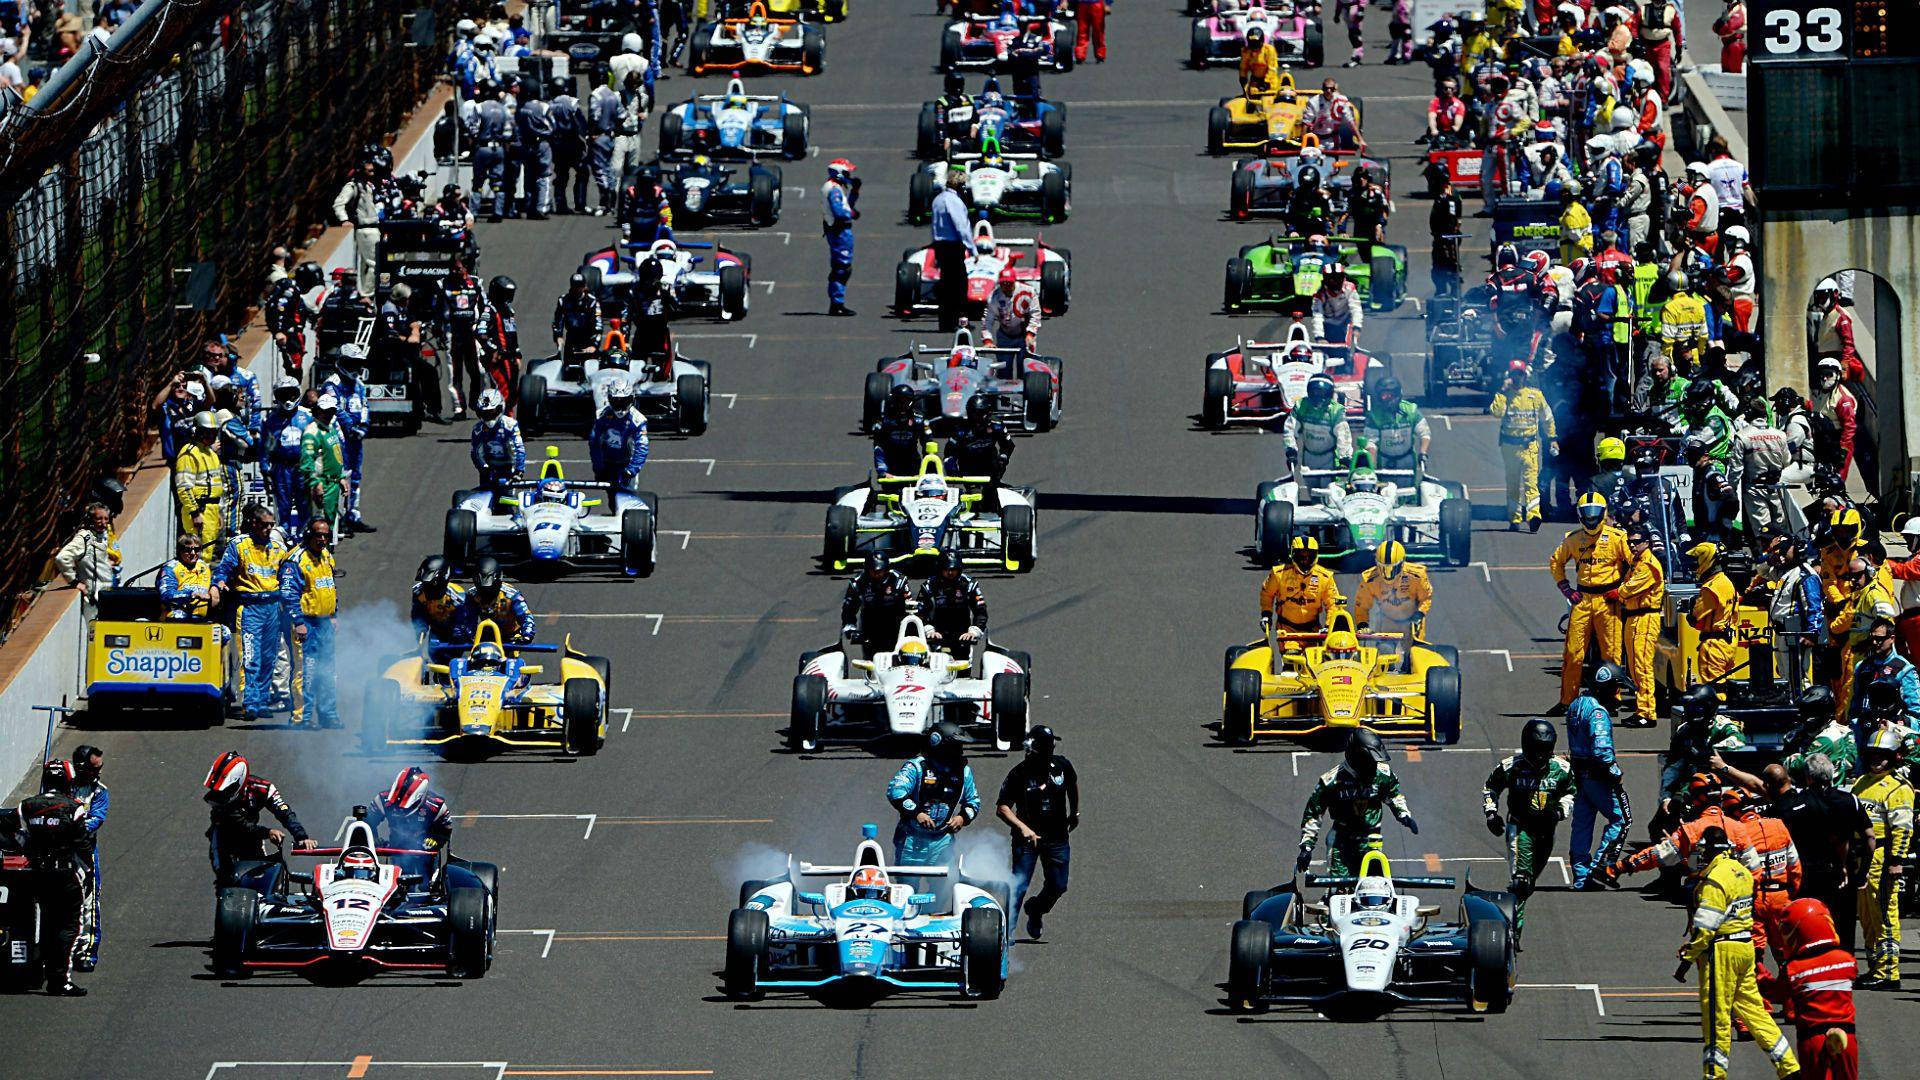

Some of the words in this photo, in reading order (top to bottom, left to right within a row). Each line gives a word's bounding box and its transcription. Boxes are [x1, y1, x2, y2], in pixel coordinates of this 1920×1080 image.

[1764, 7, 1843, 54] 33
[1750, 434, 1781, 442] HONDA
[107, 649, 202, 678] Snapple
[333, 898, 370, 911] 12
[844, 922, 888, 935] 27
[1349, 938, 1390, 950] 20
